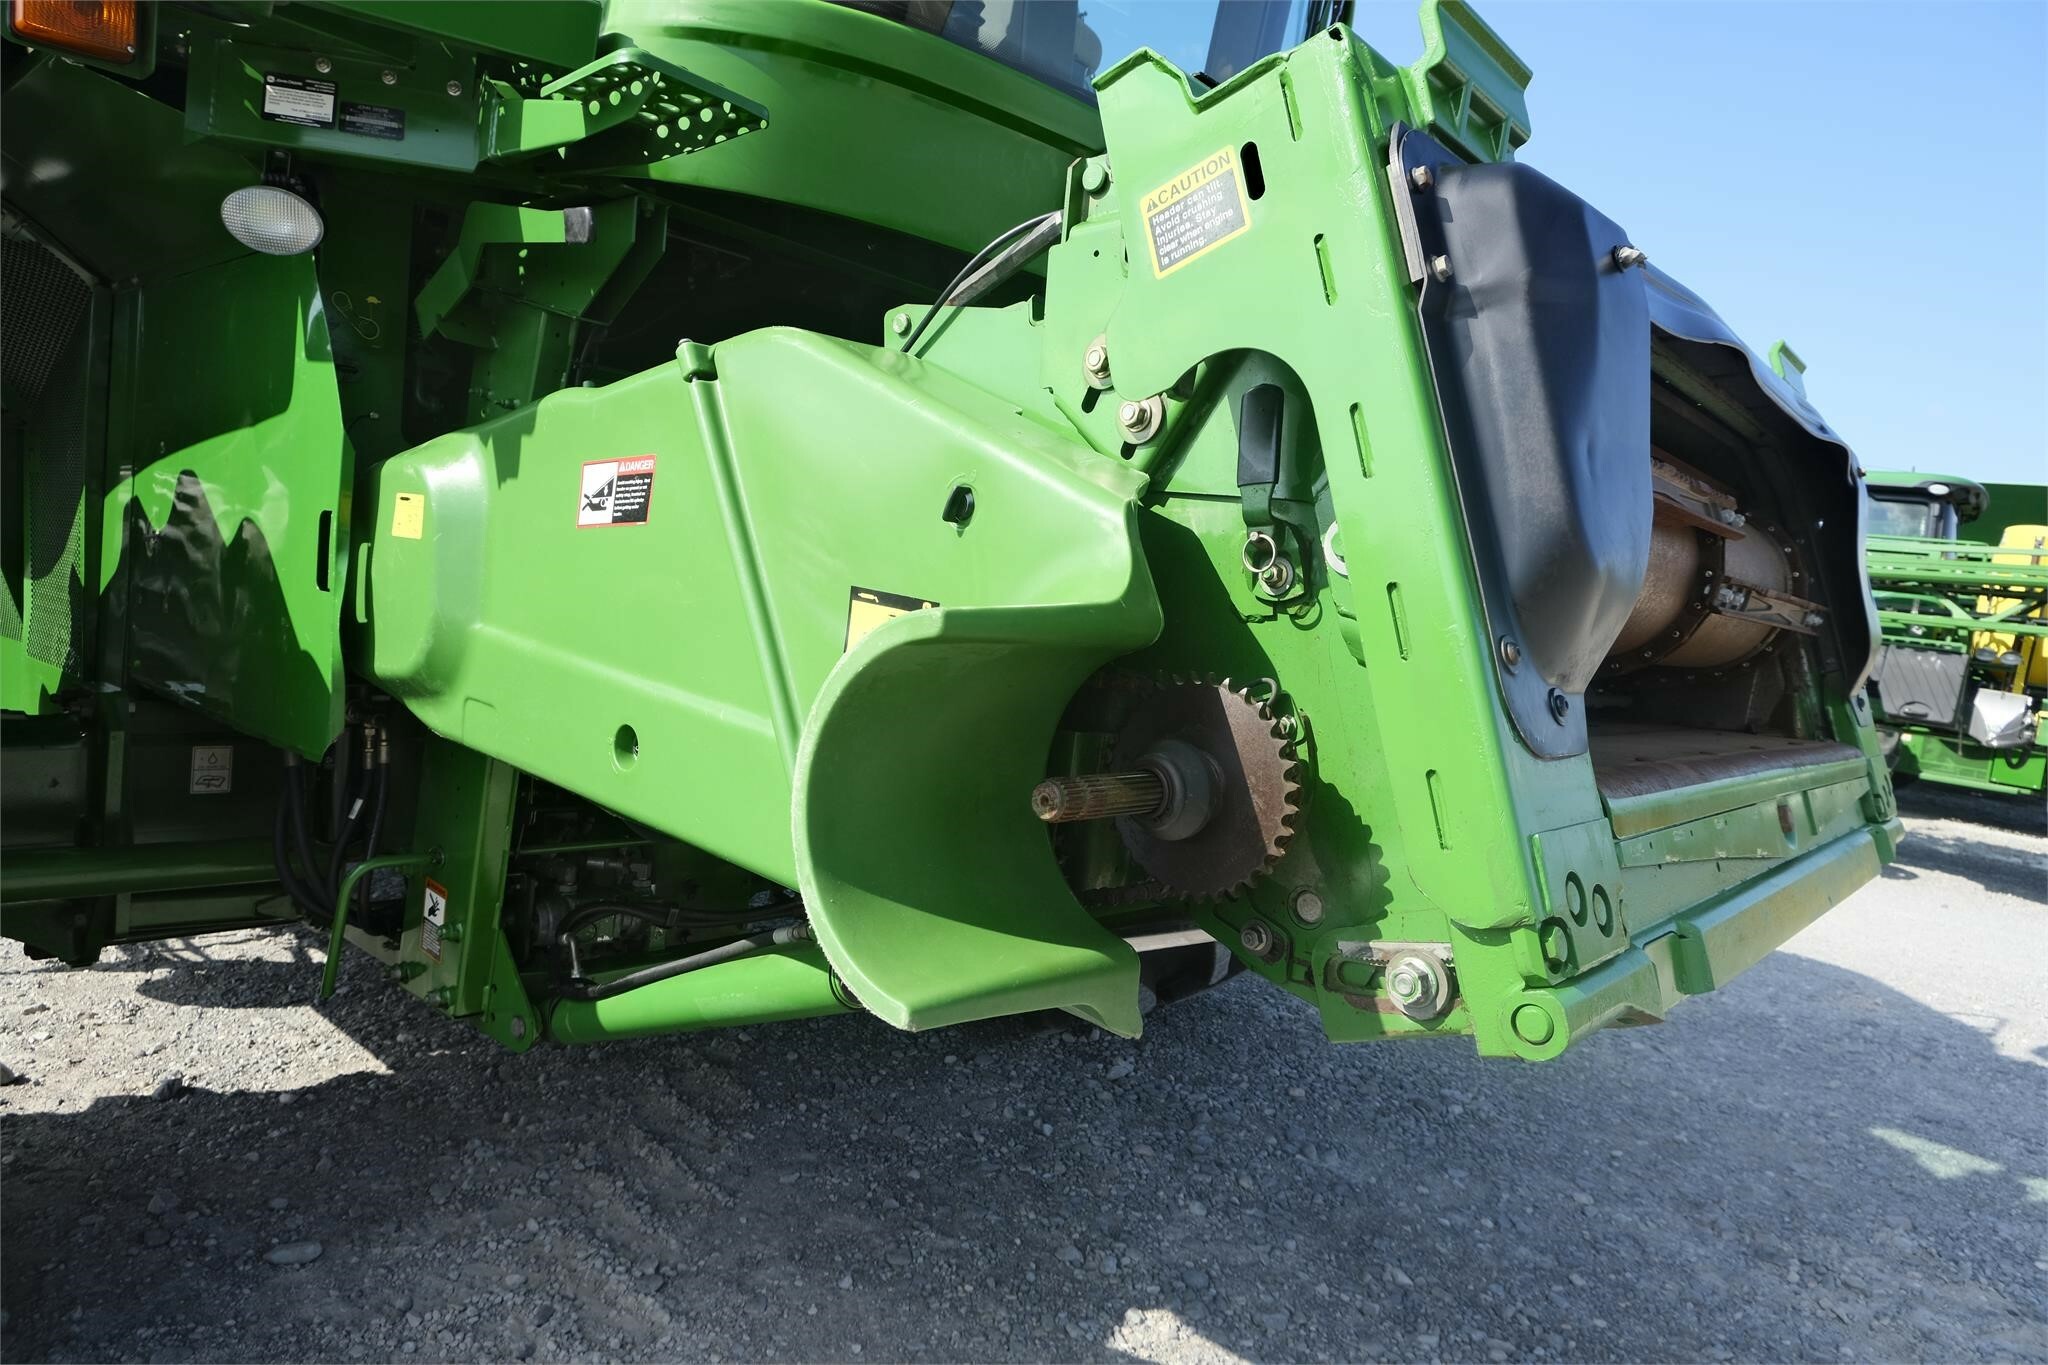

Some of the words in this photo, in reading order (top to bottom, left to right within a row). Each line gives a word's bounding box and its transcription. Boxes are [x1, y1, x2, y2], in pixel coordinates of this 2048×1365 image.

[1158, 151, 1231, 204] CAUTION
[1152, 200, 1185, 226] Header
[1187, 189, 1205, 205] can
[1206, 179, 1224, 194] tilt.
[1155, 216, 1180, 235] Avoid
[1182, 191, 1223, 219] crushing
[1196, 206, 1217, 224] Stay
[1159, 238, 1179, 256] clear
[1180, 226, 1203, 244] when
[1204, 207, 1234, 229] engine
[1161, 256, 1170, 266] is
[1171, 236, 1207, 260] running.
[625, 459, 654, 471] DANGER
